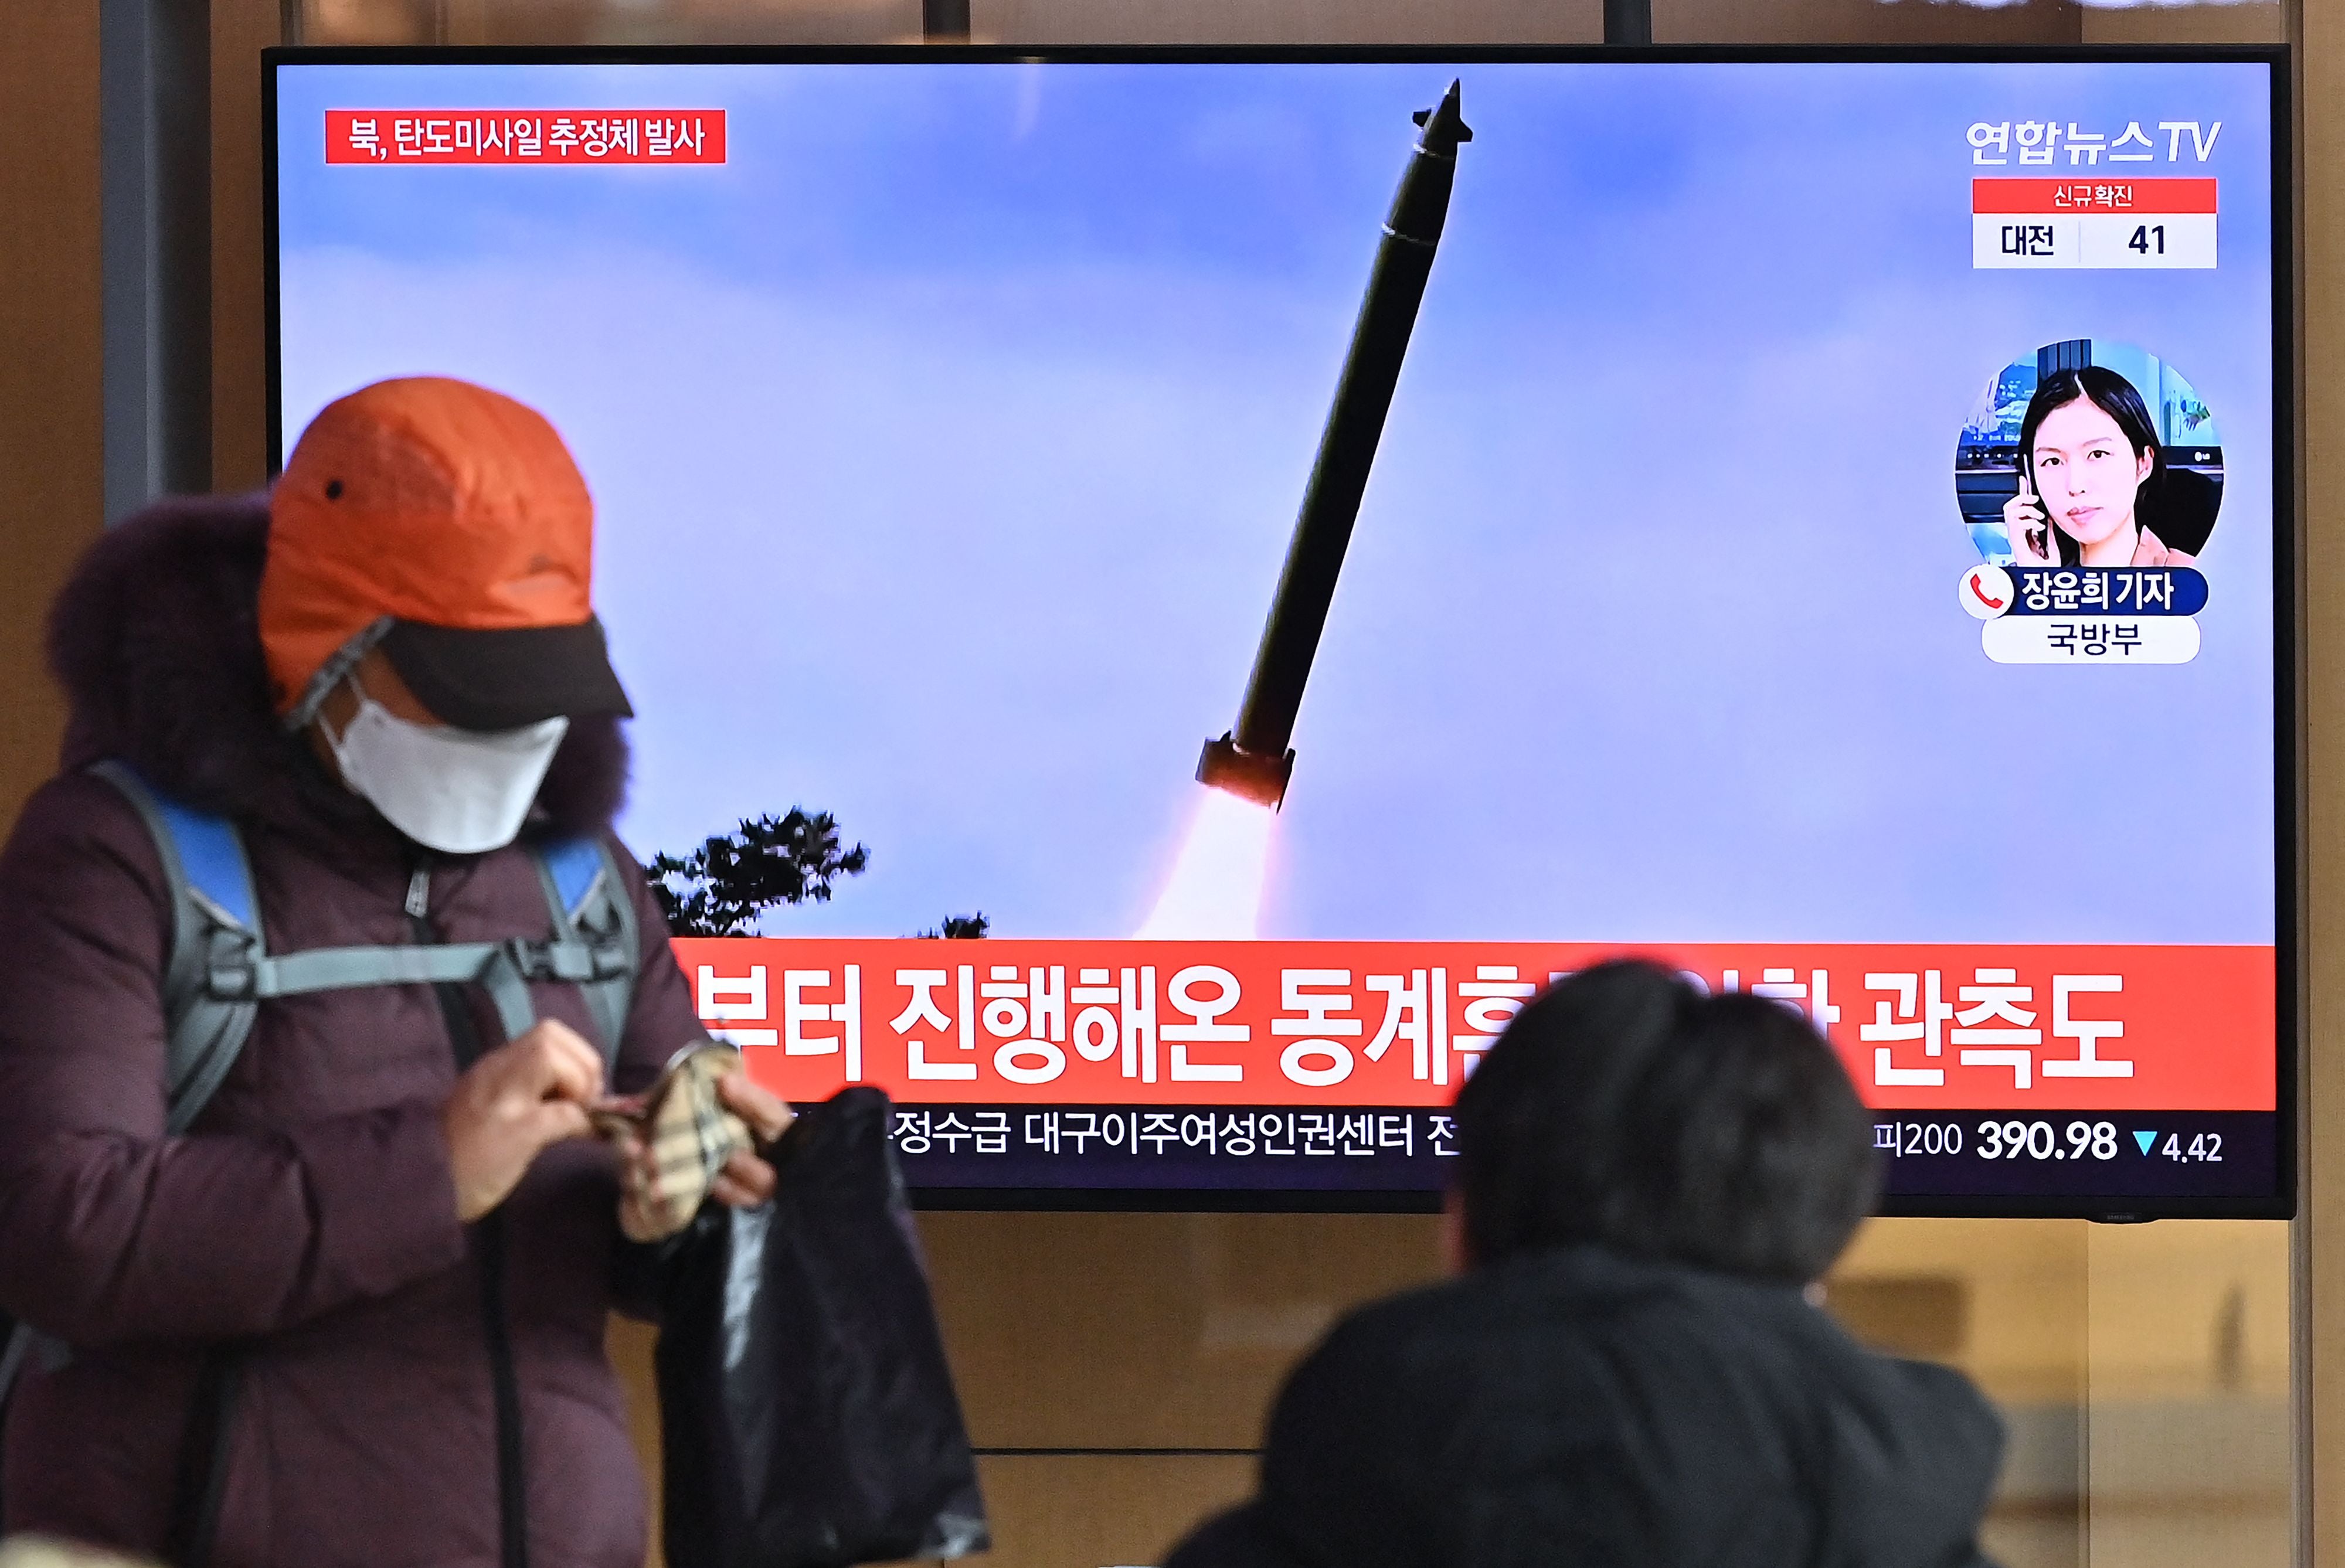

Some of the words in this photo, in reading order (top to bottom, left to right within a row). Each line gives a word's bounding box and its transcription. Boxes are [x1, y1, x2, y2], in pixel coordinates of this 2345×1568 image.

[348, 119, 388, 161] 북,
[394, 118, 542, 157] 탄도미사일
[548, 119, 639, 157] 추정체
[644, 119, 706, 157] 발사
[1966, 120, 2222, 165] 연합뉴스TV
[2001, 226, 2055, 257] 대전
[2128, 226, 2165, 255] 41
[2022, 572, 2109, 610] 장윤희
[2116, 572, 2175, 610] 기자
[2047, 624, 2143, 657] 국방부
[889, 965, 1251, 1084] 진행해온
[1859, 968, 2134, 1090] 관측도
[886, 1111, 1012, 1155] 정수급
[1024, 1111, 1413, 1157] 대구이주여성인권센터
[1976, 1120, 2119, 1161] 390.98
[2161, 1132, 2224, 1164] 4.42
